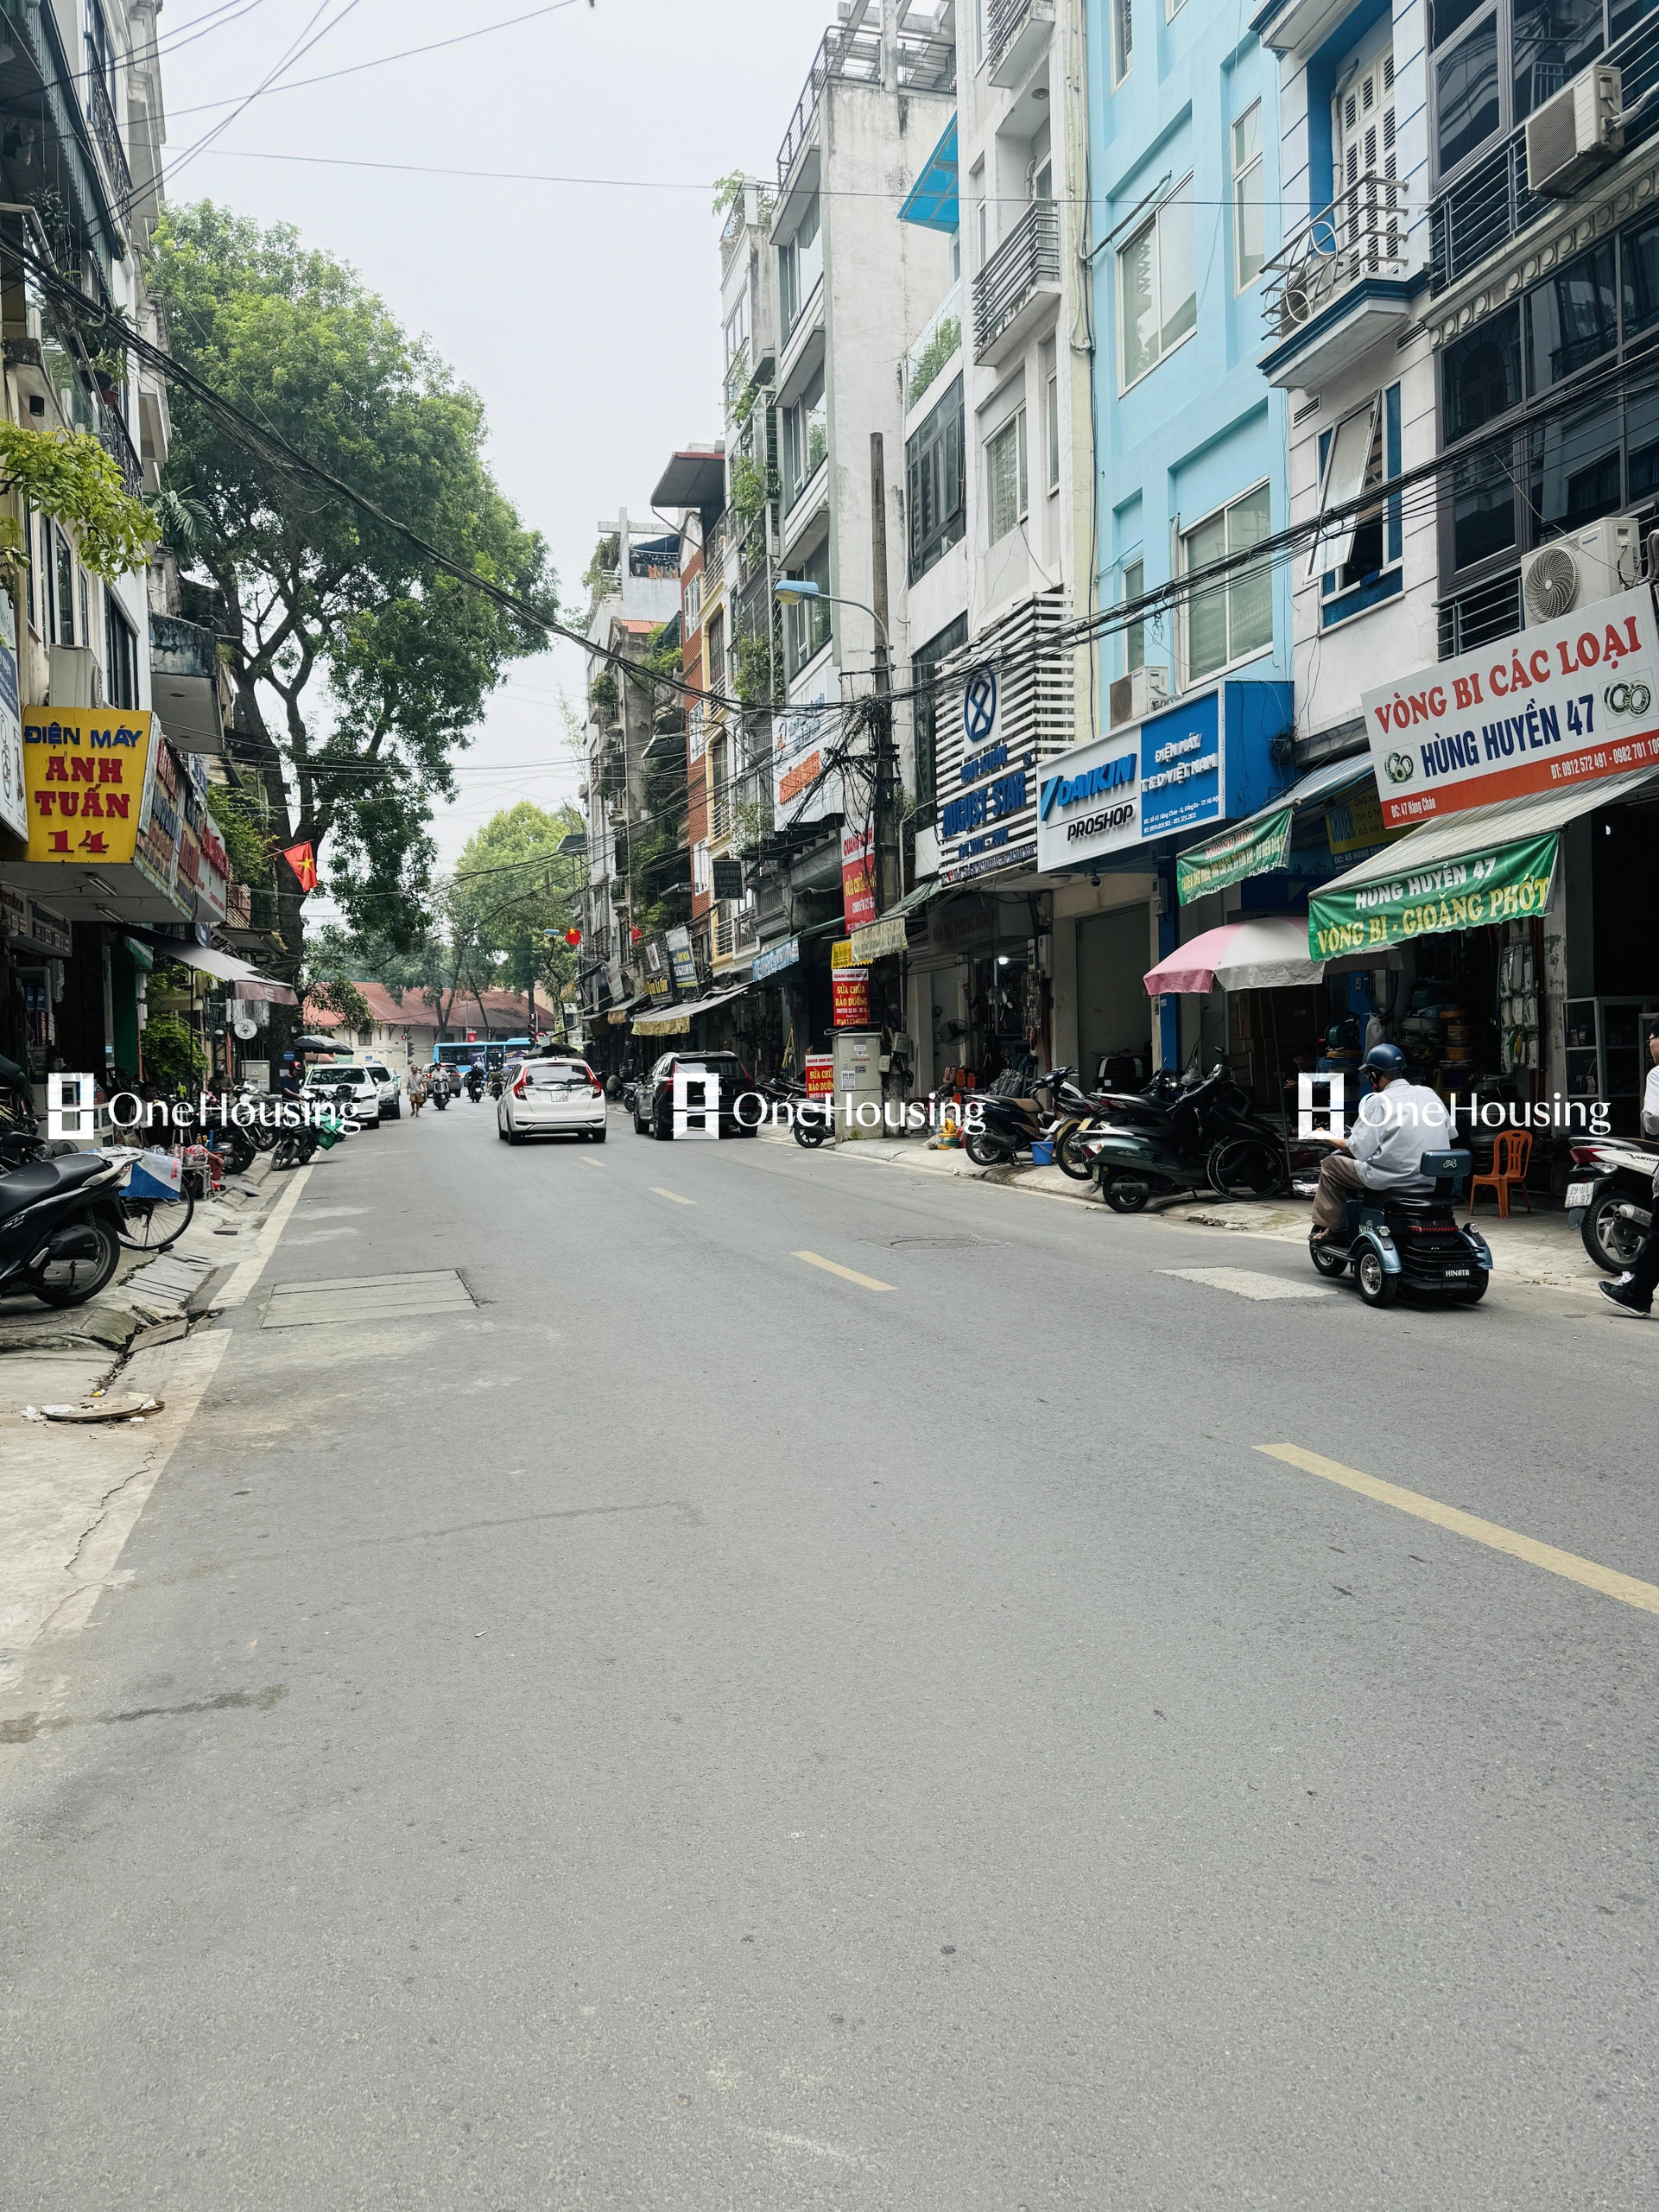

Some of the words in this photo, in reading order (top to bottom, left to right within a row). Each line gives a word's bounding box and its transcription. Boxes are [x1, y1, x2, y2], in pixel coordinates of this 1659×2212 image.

[1374, 686, 1447, 733] VÒNG
[1452, 673, 1484, 711] BI
[1489, 649, 1551, 696] CÁC
[1556, 616, 1642, 675] LOẠI
[24, 721, 80, 749] ĐIỆN
[91, 723, 142, 748] MÁY
[1155, 742, 1181, 763] ĐIỆN
[1179, 732, 1203, 754] MÁY
[1420, 732, 1480, 778] HÙNG
[1482, 698, 1561, 762] HUYỀN
[1567, 694, 1594, 736] 47
[46, 756, 123, 783] ANH
[1166, 762, 1191, 784] VIỆT
[1191, 753, 1219, 775] NAM
[1550, 764, 1562, 779] ĐT:
[1562, 759, 1580, 776] 0912
[1580, 755, 1594, 772] 572
[1594, 751, 1607, 769] 491
[1612, 745, 1632, 764] 0982
[1631, 741, 1647, 759] 701
[1057, 753, 1137, 807] DAIKIN
[35, 783, 130, 818] TUẤN
[942, 788, 988, 838] AUGUST
[991, 771, 1027, 816] STAR
[1390, 805, 1402, 818] ĐC:
[1401, 803, 1408, 815] 47
[1408, 800, 1422, 814] Hàng
[1422, 795, 1436, 811] Cháo
[1067, 804, 1134, 841] PROSHOP
[48, 829, 110, 853] 14
[1334, 856, 1345, 865] ĐC:
[1345, 853, 1352, 862] 45
[1353, 848, 1369, 860] HÀNG
[1356, 882, 1403, 910] HÙNG
[1409, 862, 1466, 895] HUYỀN
[1472, 857, 1497, 879] 47
[1317, 921, 1365, 954] VÒNG
[1369, 916, 1387, 943] BI
[1403, 892, 1482, 935] GIOĂNG
[1489, 872, 1550, 917] PHỚT
[835, 995, 847, 1006] BẢO
[837, 983, 849, 994] SỬA
[808, 1080, 820, 1092] BẢO
[810, 1068, 820, 1079] SỬA
[821, 1068, 834, 1079] CHỮ
